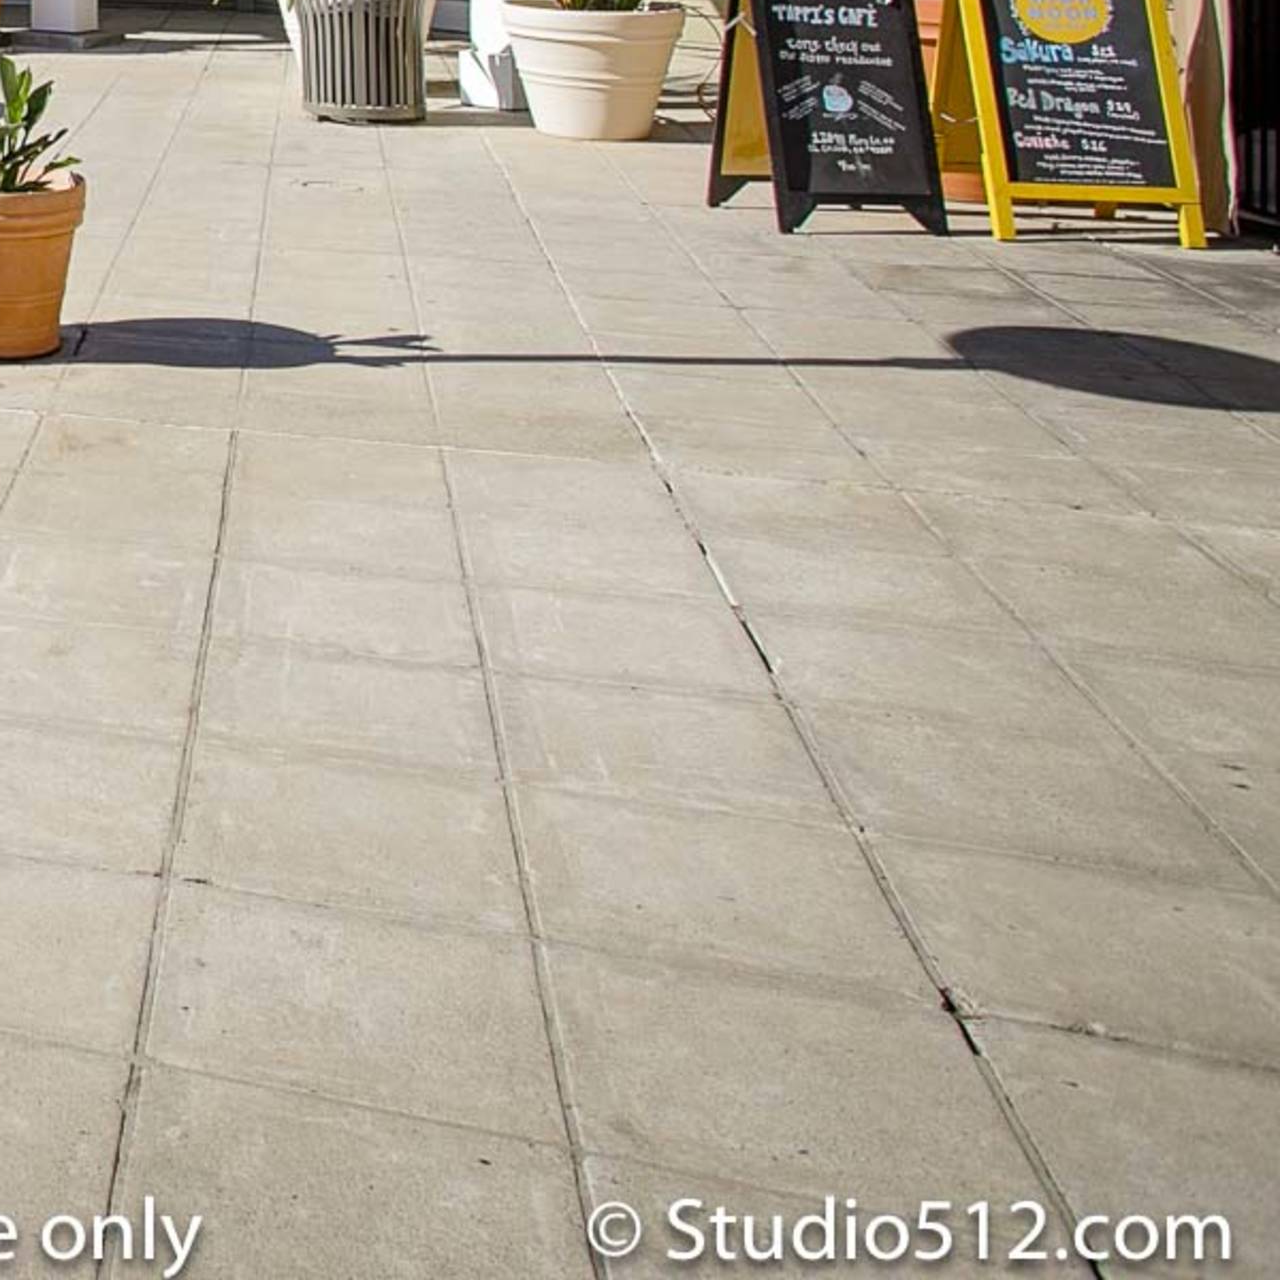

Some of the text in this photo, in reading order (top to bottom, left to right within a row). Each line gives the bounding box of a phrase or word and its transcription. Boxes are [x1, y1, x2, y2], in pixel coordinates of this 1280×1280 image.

[1000, 36, 1074, 64] Sakura
[1006, 86, 1038, 110] Red
[1040, 91, 1101, 120] Dragon
